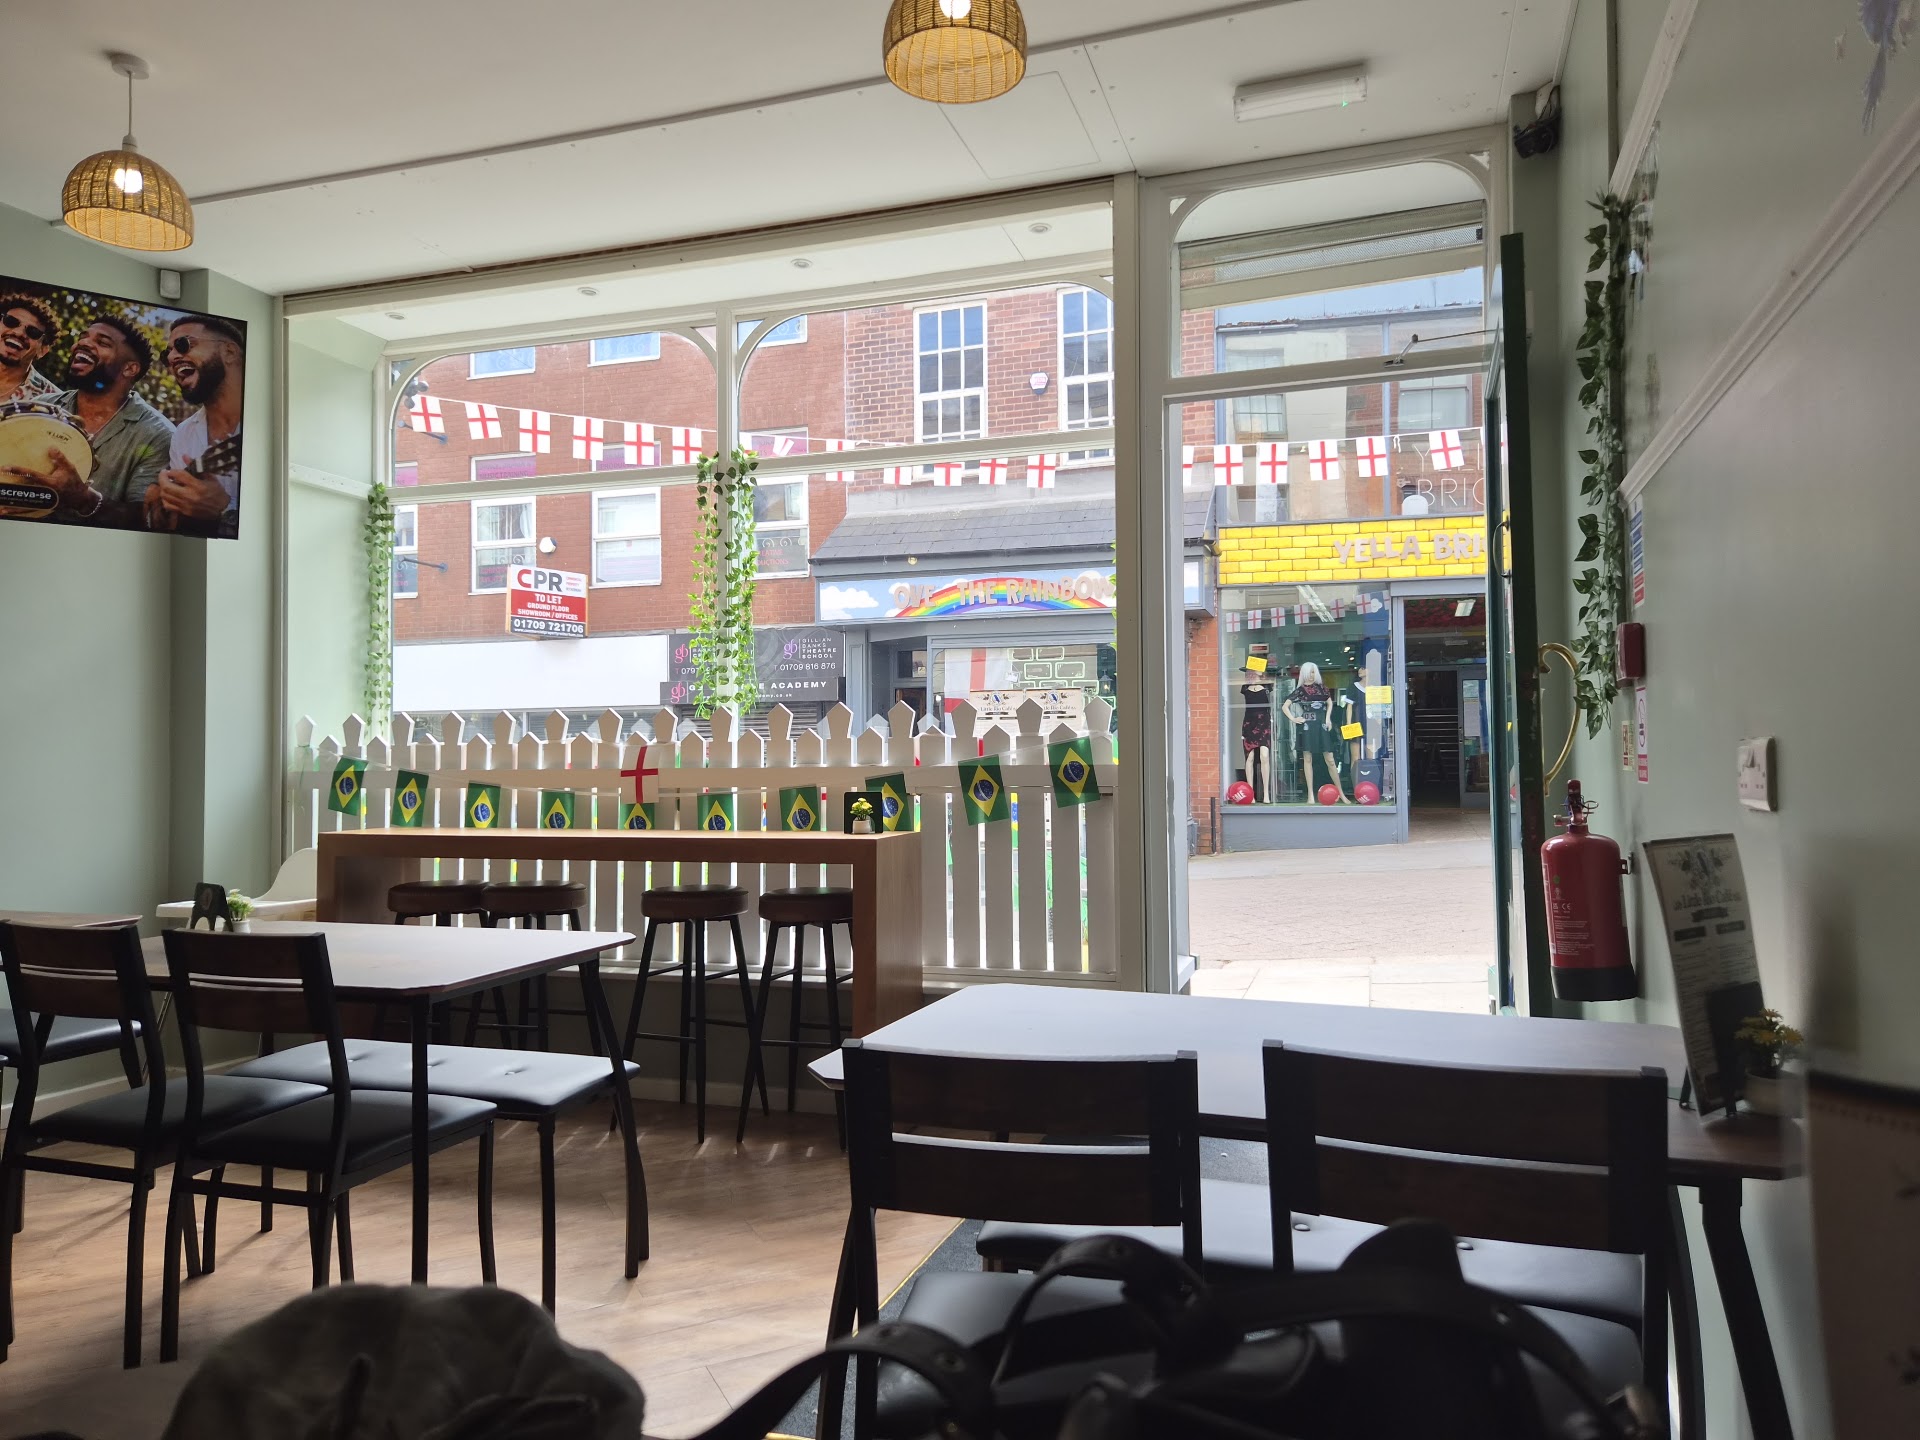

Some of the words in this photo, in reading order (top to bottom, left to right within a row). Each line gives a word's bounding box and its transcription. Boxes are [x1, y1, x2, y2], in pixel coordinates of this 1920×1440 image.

[0, 489, 52, 499] screva-se
[1334, 535, 1422, 564] YELLA
[1434, 533, 1486, 560] BRI
[517, 569, 563, 592] CPR
[957, 580, 998, 605] THE
[1006, 576, 1116, 605] RAINBOW
[534, 594, 546, 602] TO
[547, 594, 562, 604] LET
[527, 602, 550, 610] GROUND
[518, 609, 550, 617] SHOWROOM
[514, 619, 546, 630] 01709
[548, 622, 583, 633] 721706
